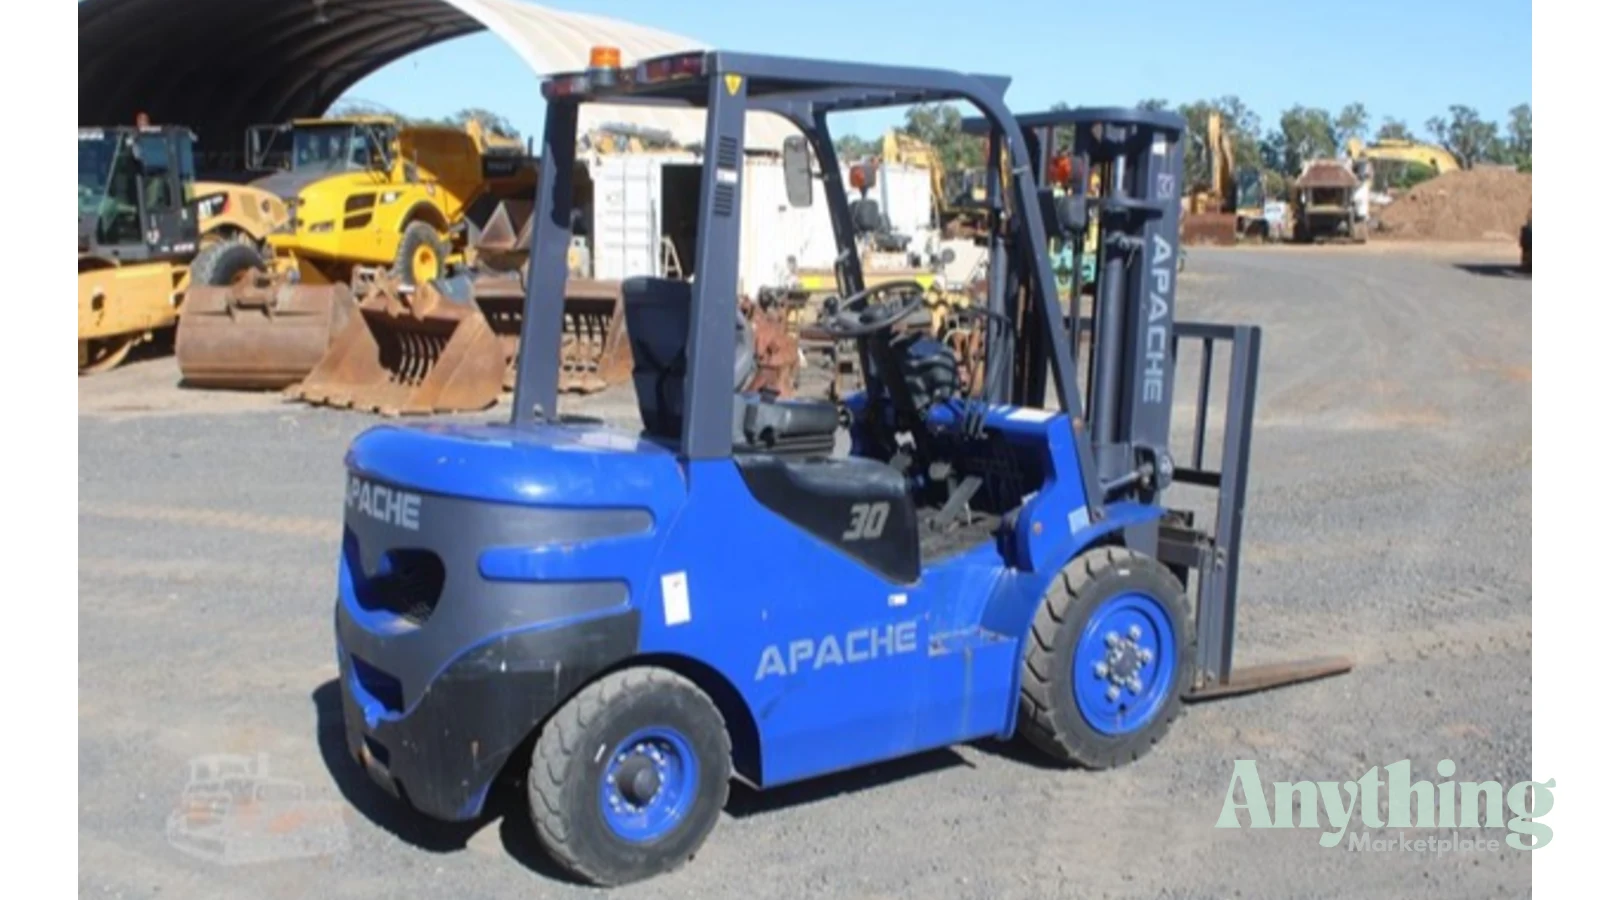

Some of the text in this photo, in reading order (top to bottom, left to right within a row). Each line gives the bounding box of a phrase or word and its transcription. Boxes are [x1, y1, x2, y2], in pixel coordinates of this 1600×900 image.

[1143, 234, 1172, 402] APACHE
[843, 501, 890, 541] 30
[754, 620, 918, 682] APACHE
